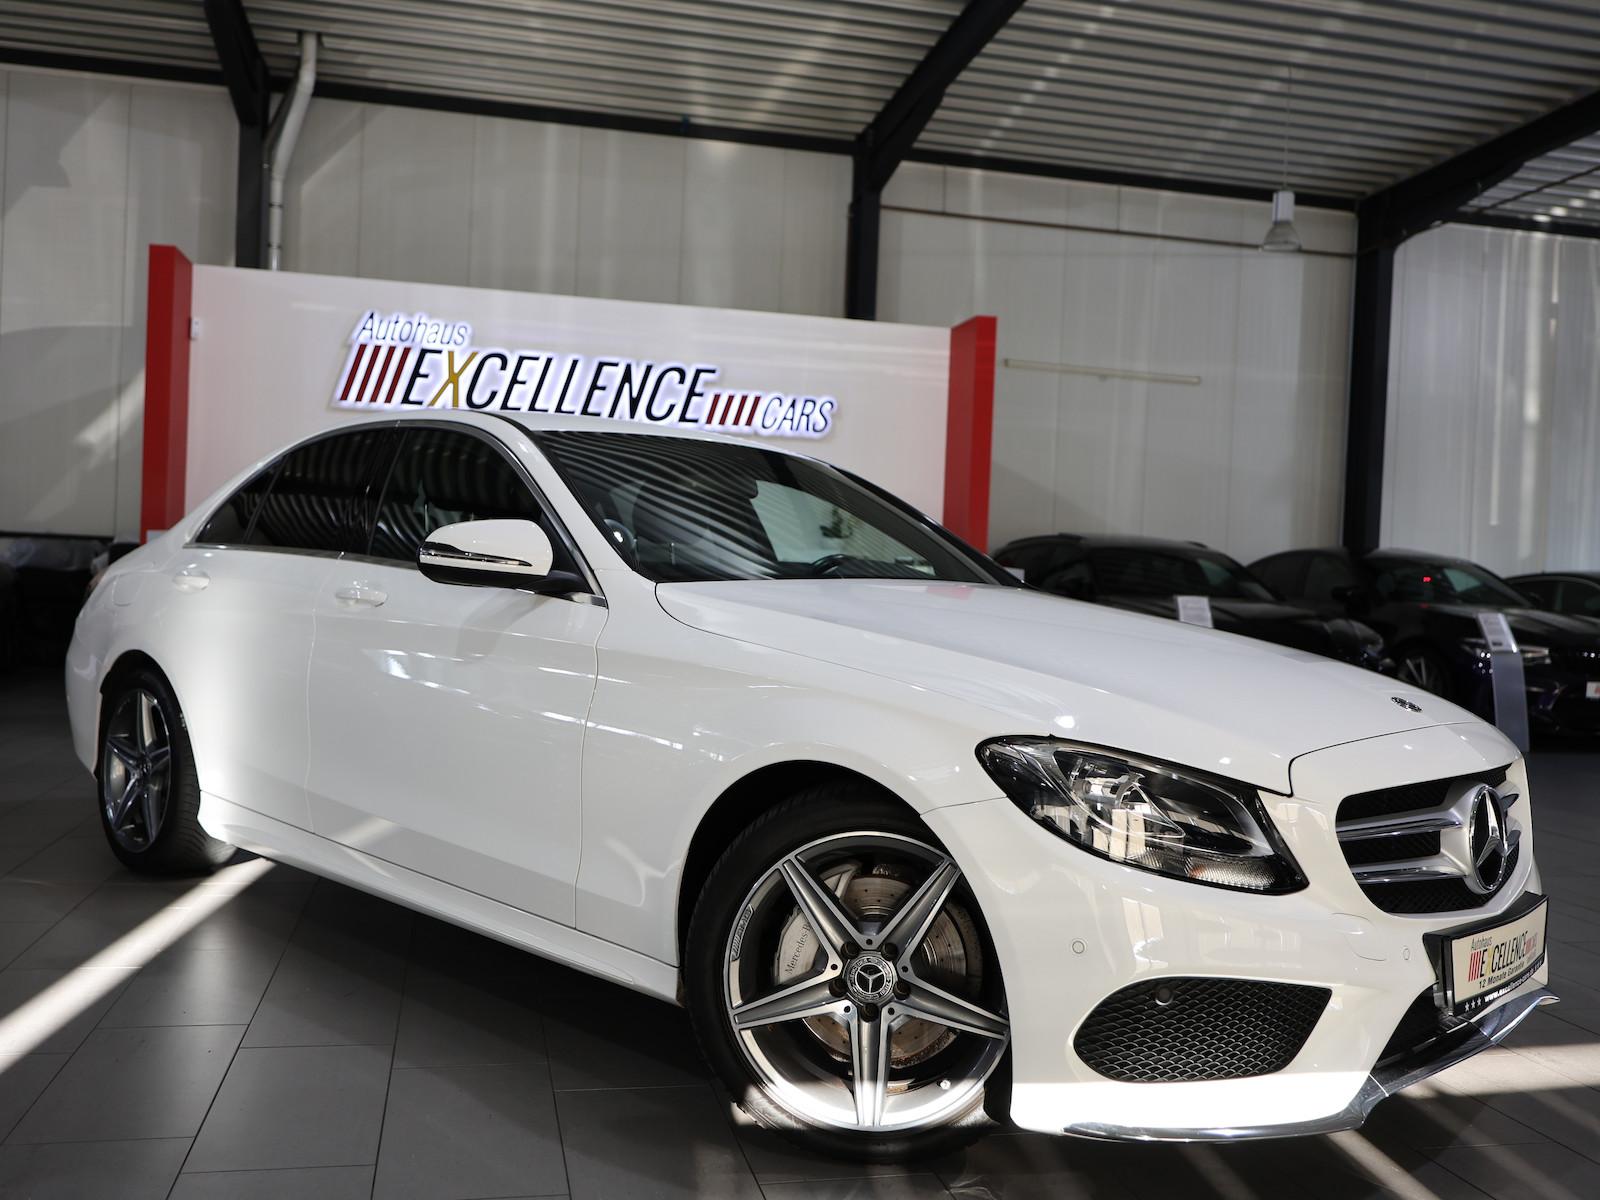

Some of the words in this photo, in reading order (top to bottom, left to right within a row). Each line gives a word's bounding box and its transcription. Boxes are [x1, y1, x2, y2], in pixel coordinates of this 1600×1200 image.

[357, 312, 468, 346] Autohaus
[401, 348, 717, 424] EXCELLENCE
[761, 397, 834, 433] CARS
[785, 922, 811, 975] Mercedes-B
[1480, 978, 1487, 989] 12
